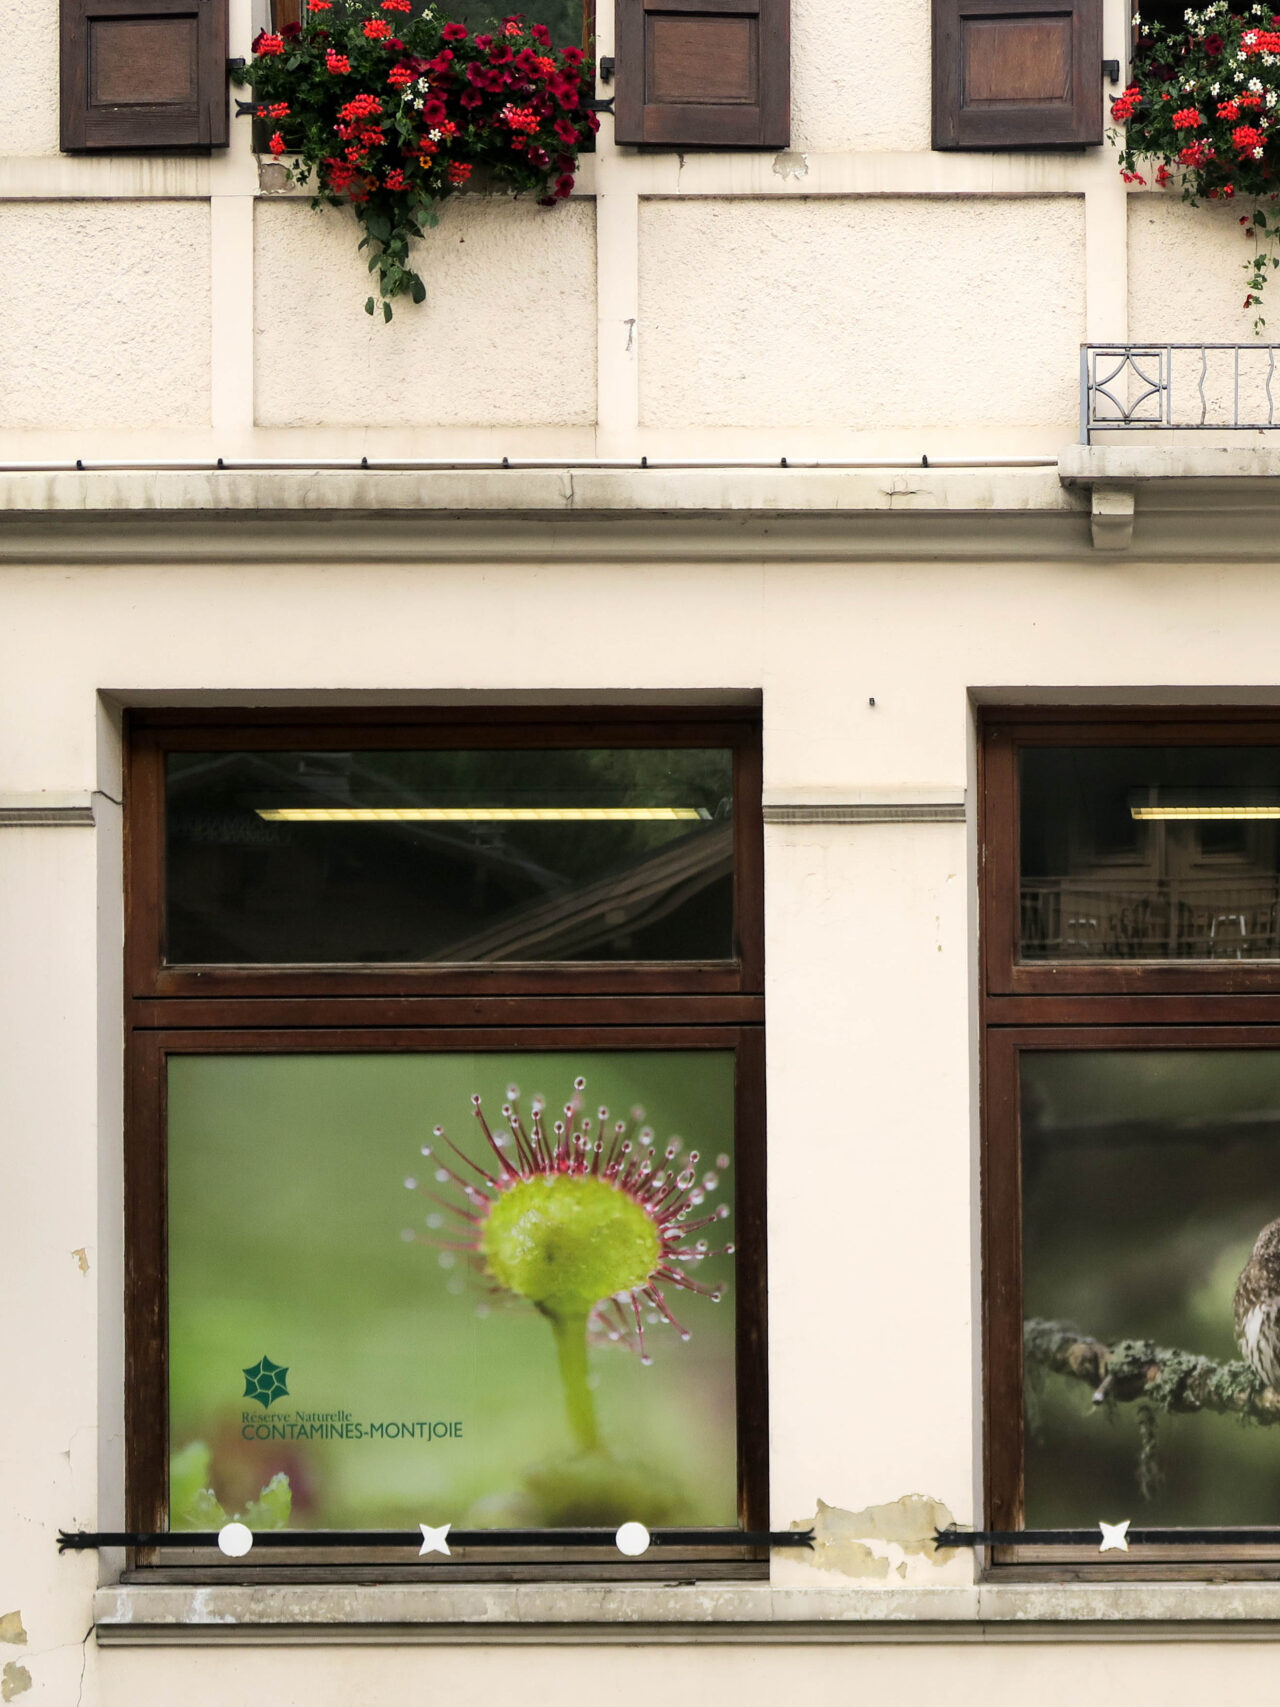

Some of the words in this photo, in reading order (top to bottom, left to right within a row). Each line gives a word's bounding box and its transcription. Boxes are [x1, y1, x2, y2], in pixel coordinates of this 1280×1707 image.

[242, 1411, 291, 1423] Réserve
[295, 1410, 353, 1422] Naturelle
[241, 1422, 464, 1442] CONTAMINES-MONTJOIE
